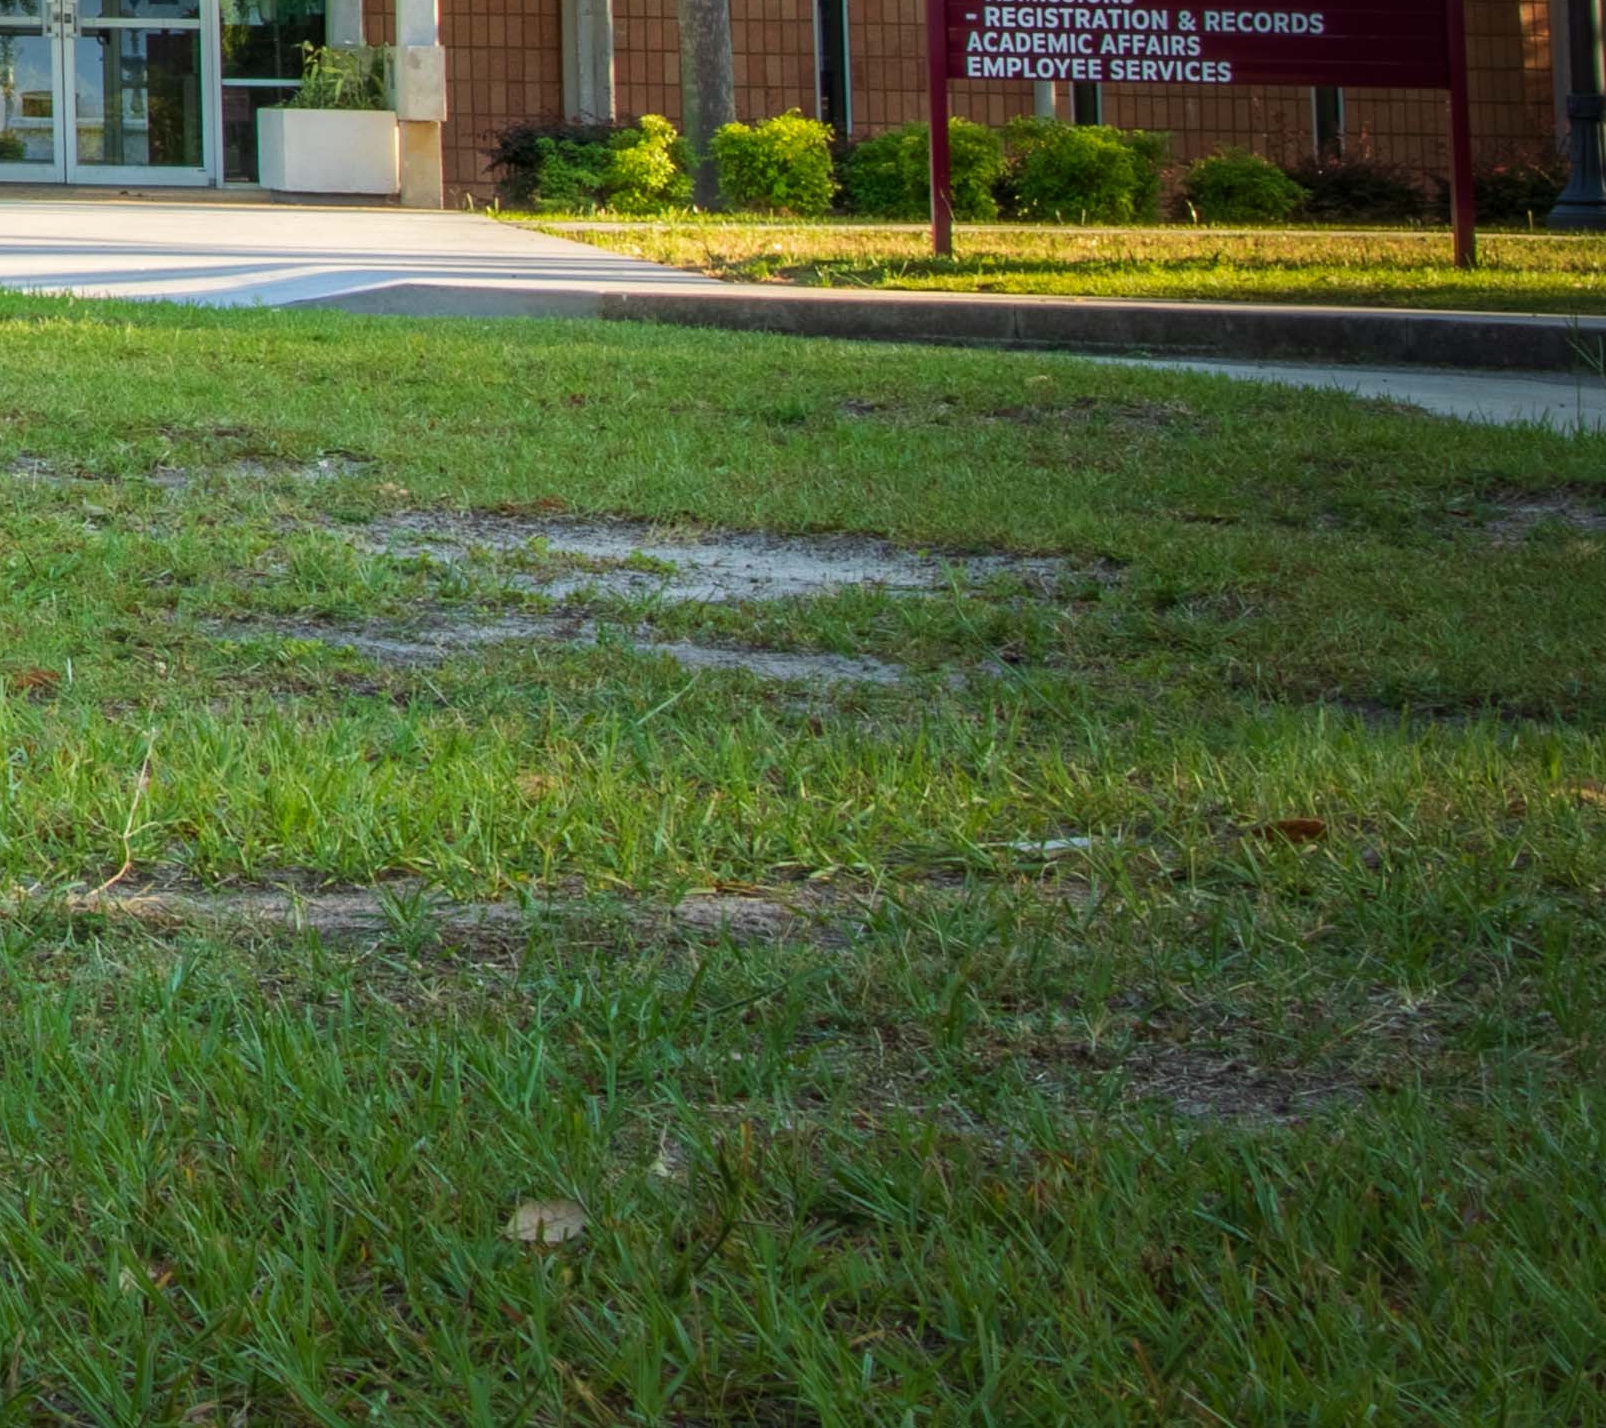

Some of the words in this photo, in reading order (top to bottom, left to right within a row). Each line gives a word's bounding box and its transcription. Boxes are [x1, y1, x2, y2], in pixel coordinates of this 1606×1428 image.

[983, 6, 1168, 30] REGISTRATION
[1177, 10, 1197, 32] &
[1203, 11, 1325, 34] RECORDS
[966, 30, 1093, 55] ACADEMIC
[1100, 33, 1202, 56] AFFAIRS
[966, 56, 1102, 80] EMPLOYEE
[1110, 59, 1233, 83] SERVICES
